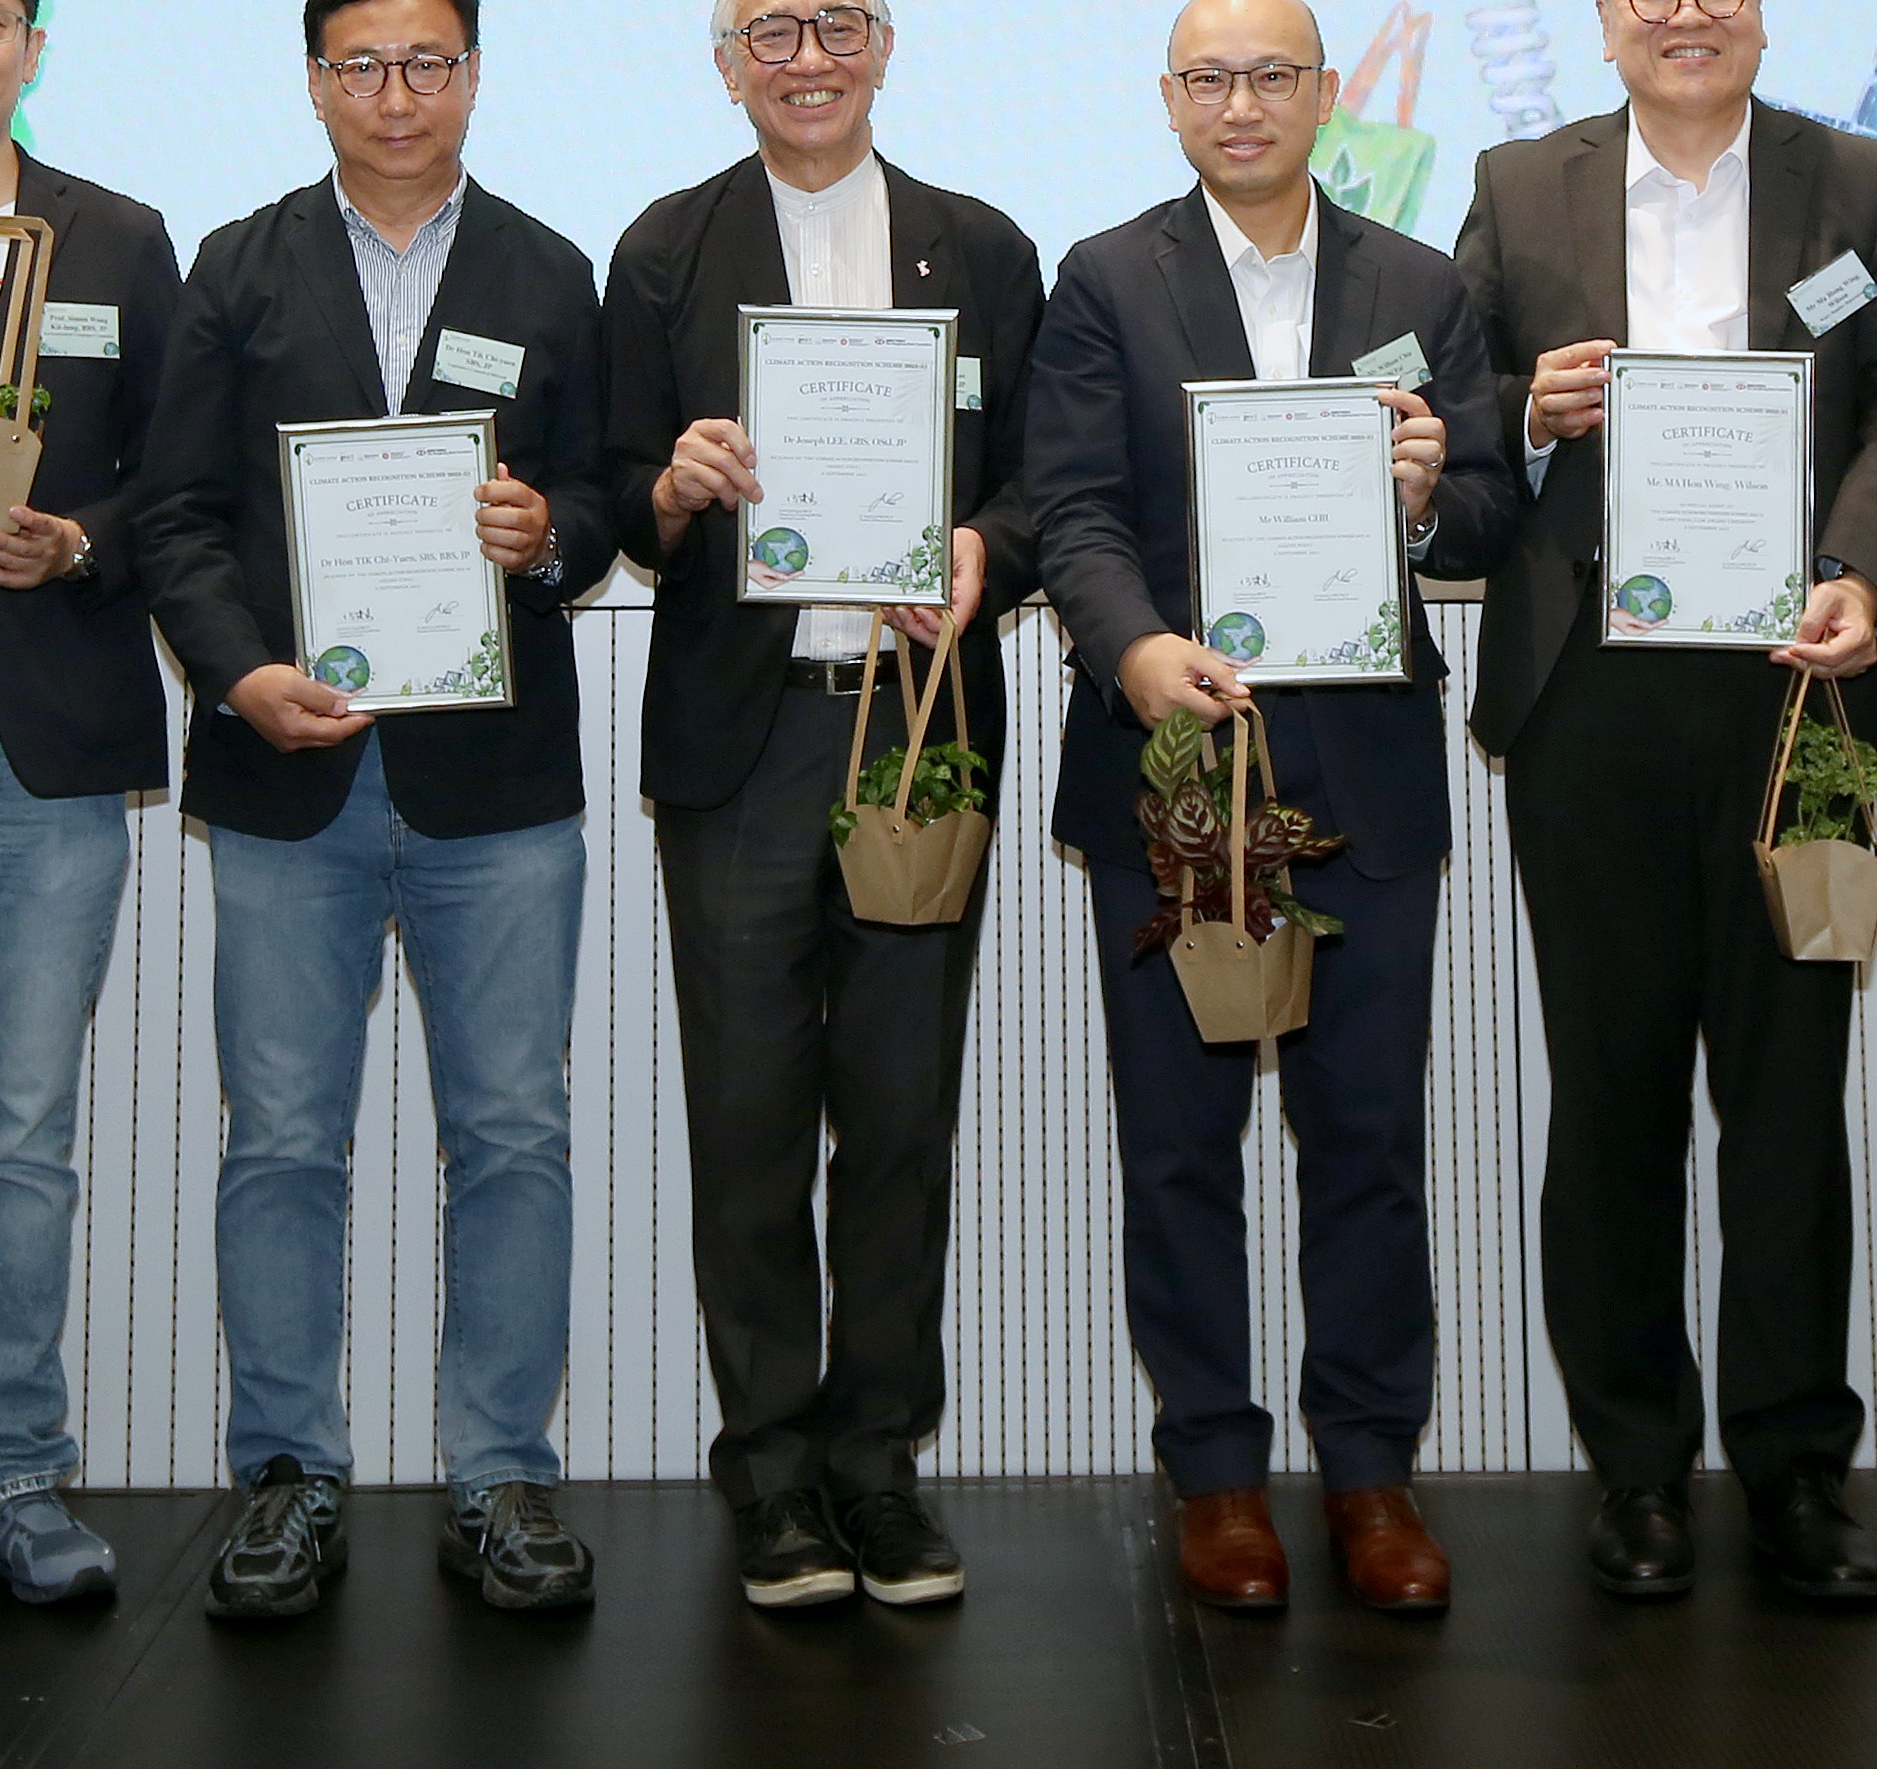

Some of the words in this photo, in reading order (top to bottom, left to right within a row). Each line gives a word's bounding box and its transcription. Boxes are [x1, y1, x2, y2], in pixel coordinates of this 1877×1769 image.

[799, 381, 892, 397] CERTIFICATE
[1662, 426, 1754, 443] CERTIFICATE
[1247, 456, 1340, 474] CERTIFICATE
[346, 494, 439, 512] CERTIFICATE
[320, 559, 332, 568] Dr
[334, 557, 353, 567] Hon
[355, 556, 373, 566] TIK
[460, 550, 471, 560] JP
